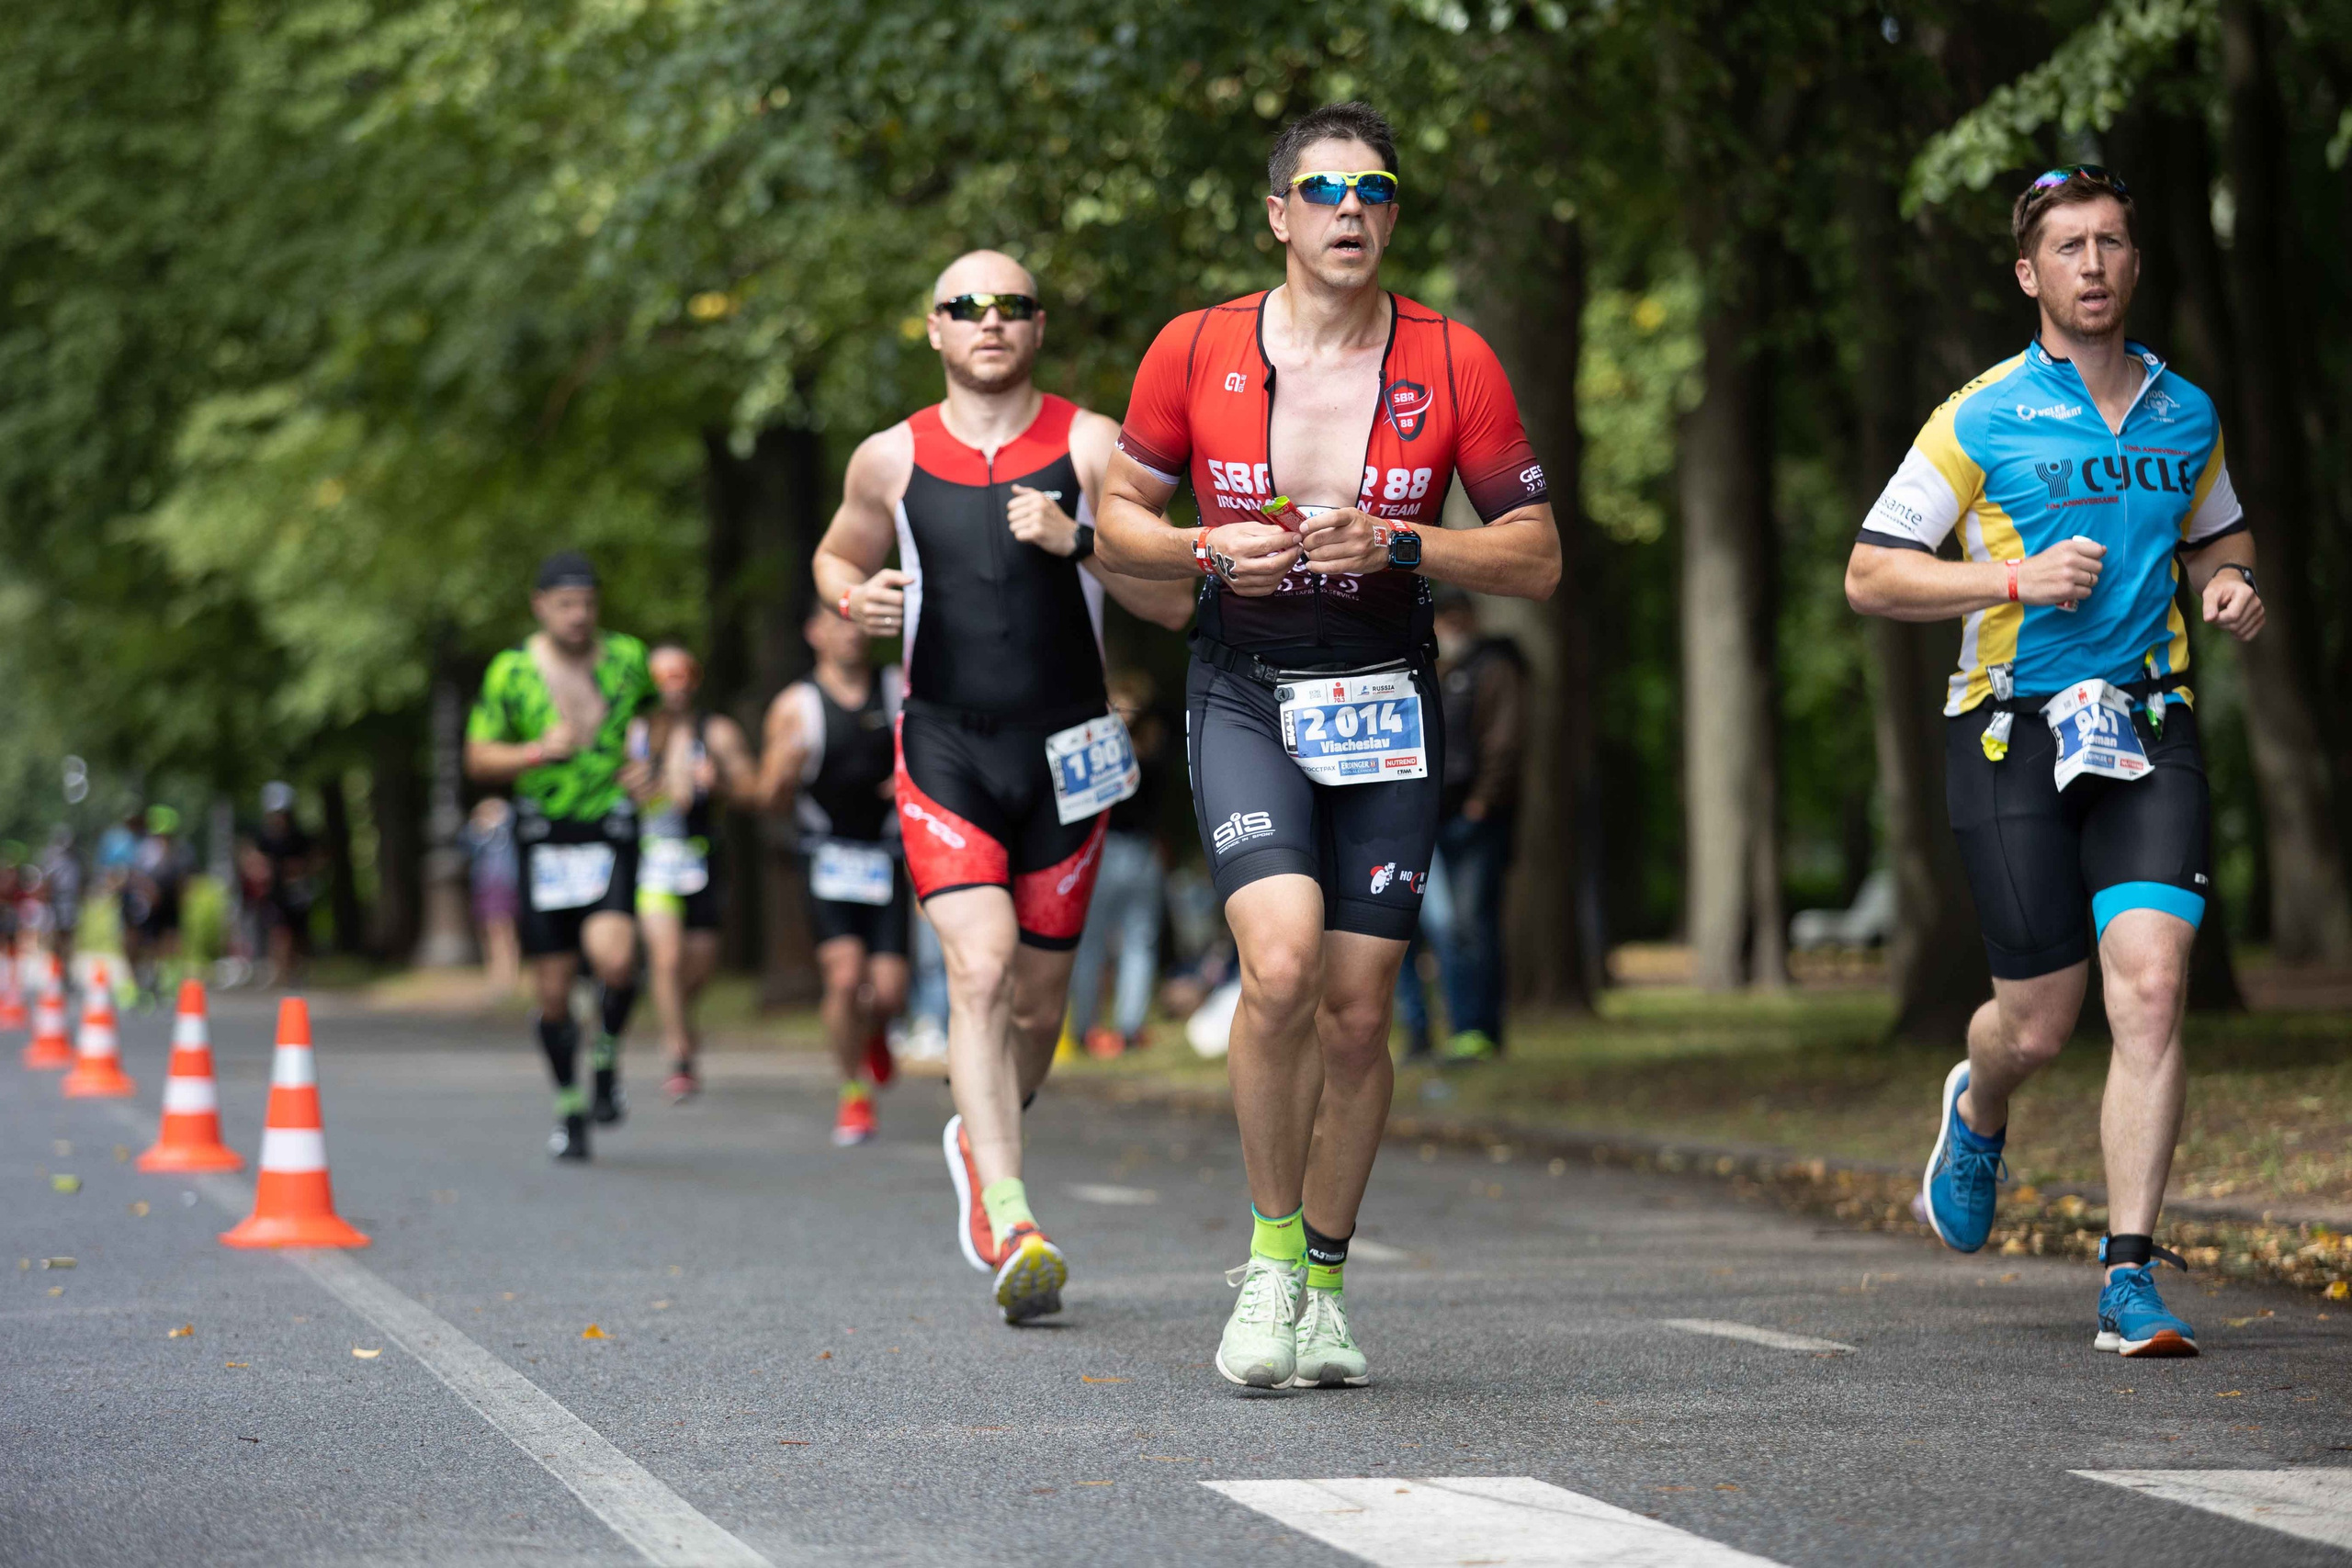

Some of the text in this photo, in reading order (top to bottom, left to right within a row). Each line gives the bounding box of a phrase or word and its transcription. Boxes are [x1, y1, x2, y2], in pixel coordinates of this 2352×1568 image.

[1394, 392, 1415, 403] SBR
[1400, 419, 1414, 428] 88
[2082, 455, 2192, 496] CYCLE
[1383, 467, 1432, 501] 88
[1379, 502, 1421, 516] TEAM
[1320, 737, 1391, 753] Viacheslav
[1340, 761, 1370, 770] ERDINGER
[1386, 758, 1416, 767] NUTREND
